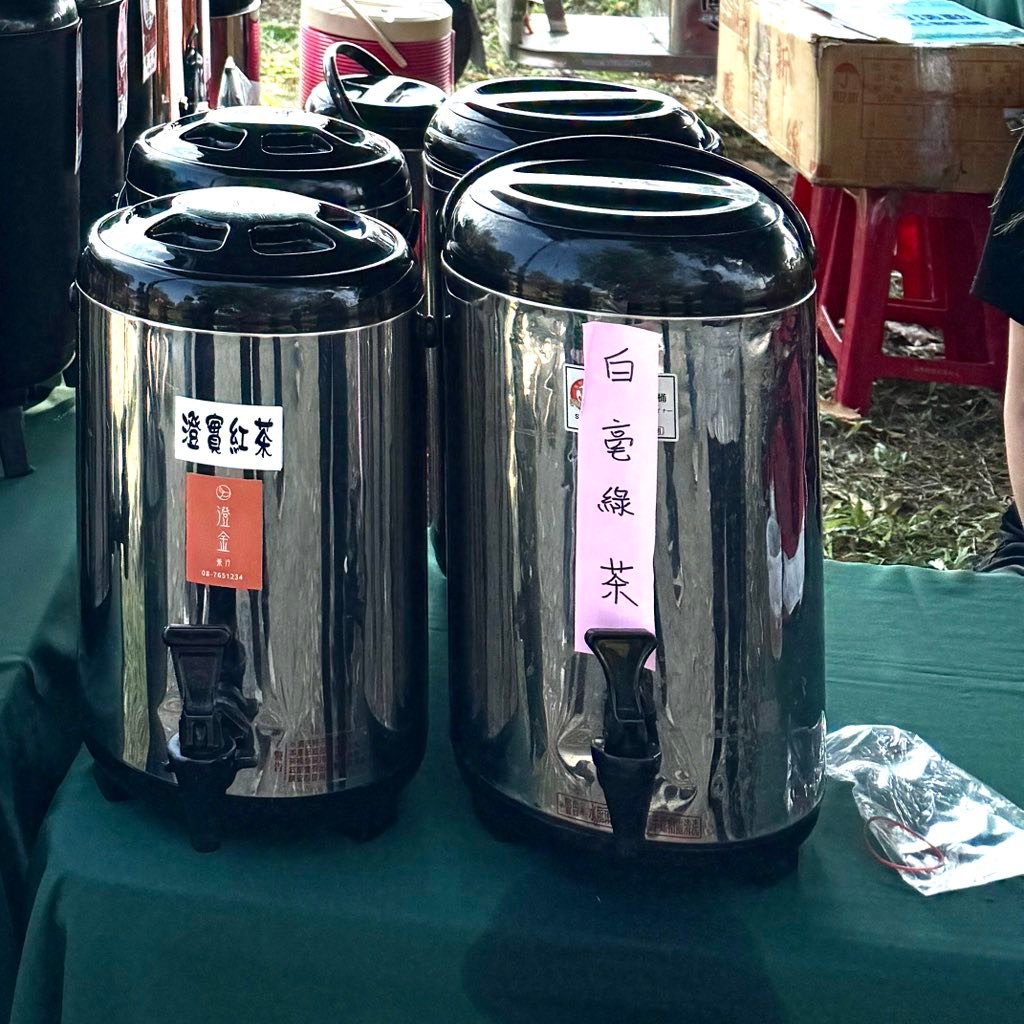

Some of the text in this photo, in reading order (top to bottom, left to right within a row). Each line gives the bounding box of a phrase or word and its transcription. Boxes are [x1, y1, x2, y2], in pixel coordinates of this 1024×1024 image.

[597, 347, 639, 607] 白毫綠茶
[201, 569, 243, 581] 08-7651234
